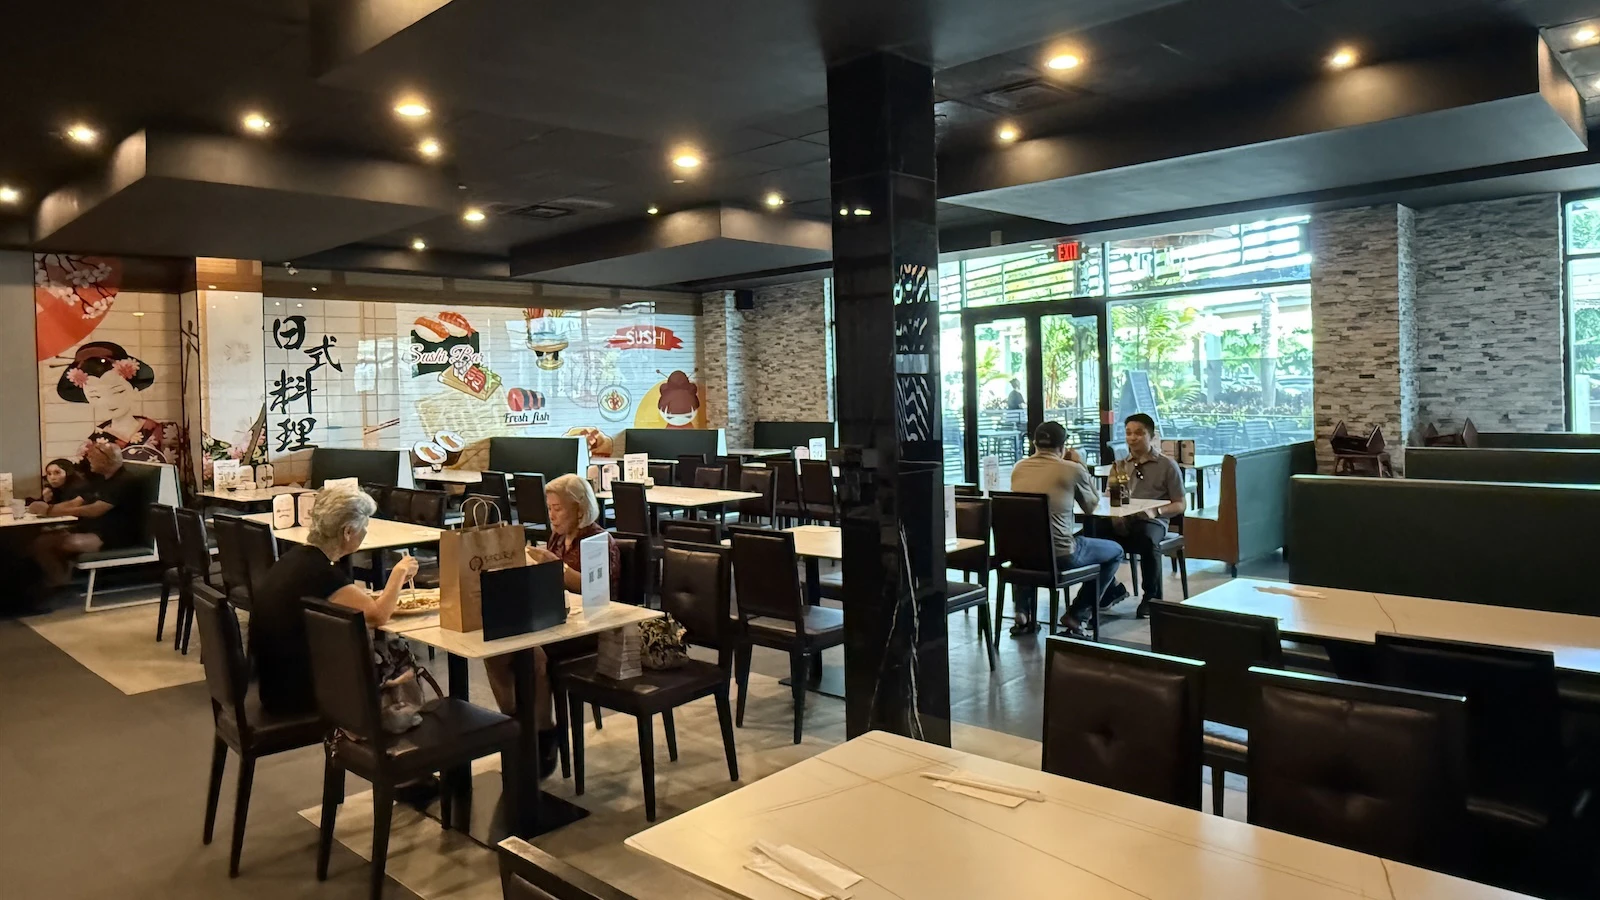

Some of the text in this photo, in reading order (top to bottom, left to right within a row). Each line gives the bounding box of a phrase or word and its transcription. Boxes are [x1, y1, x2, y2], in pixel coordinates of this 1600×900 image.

[1058, 243, 1079, 261] EXIT
[625, 330, 666, 345] SUSHI
[405, 343, 484, 364] Sushi Bar
[269, 315, 343, 452] 日式料理
[504, 411, 550, 424] Fresh fish
